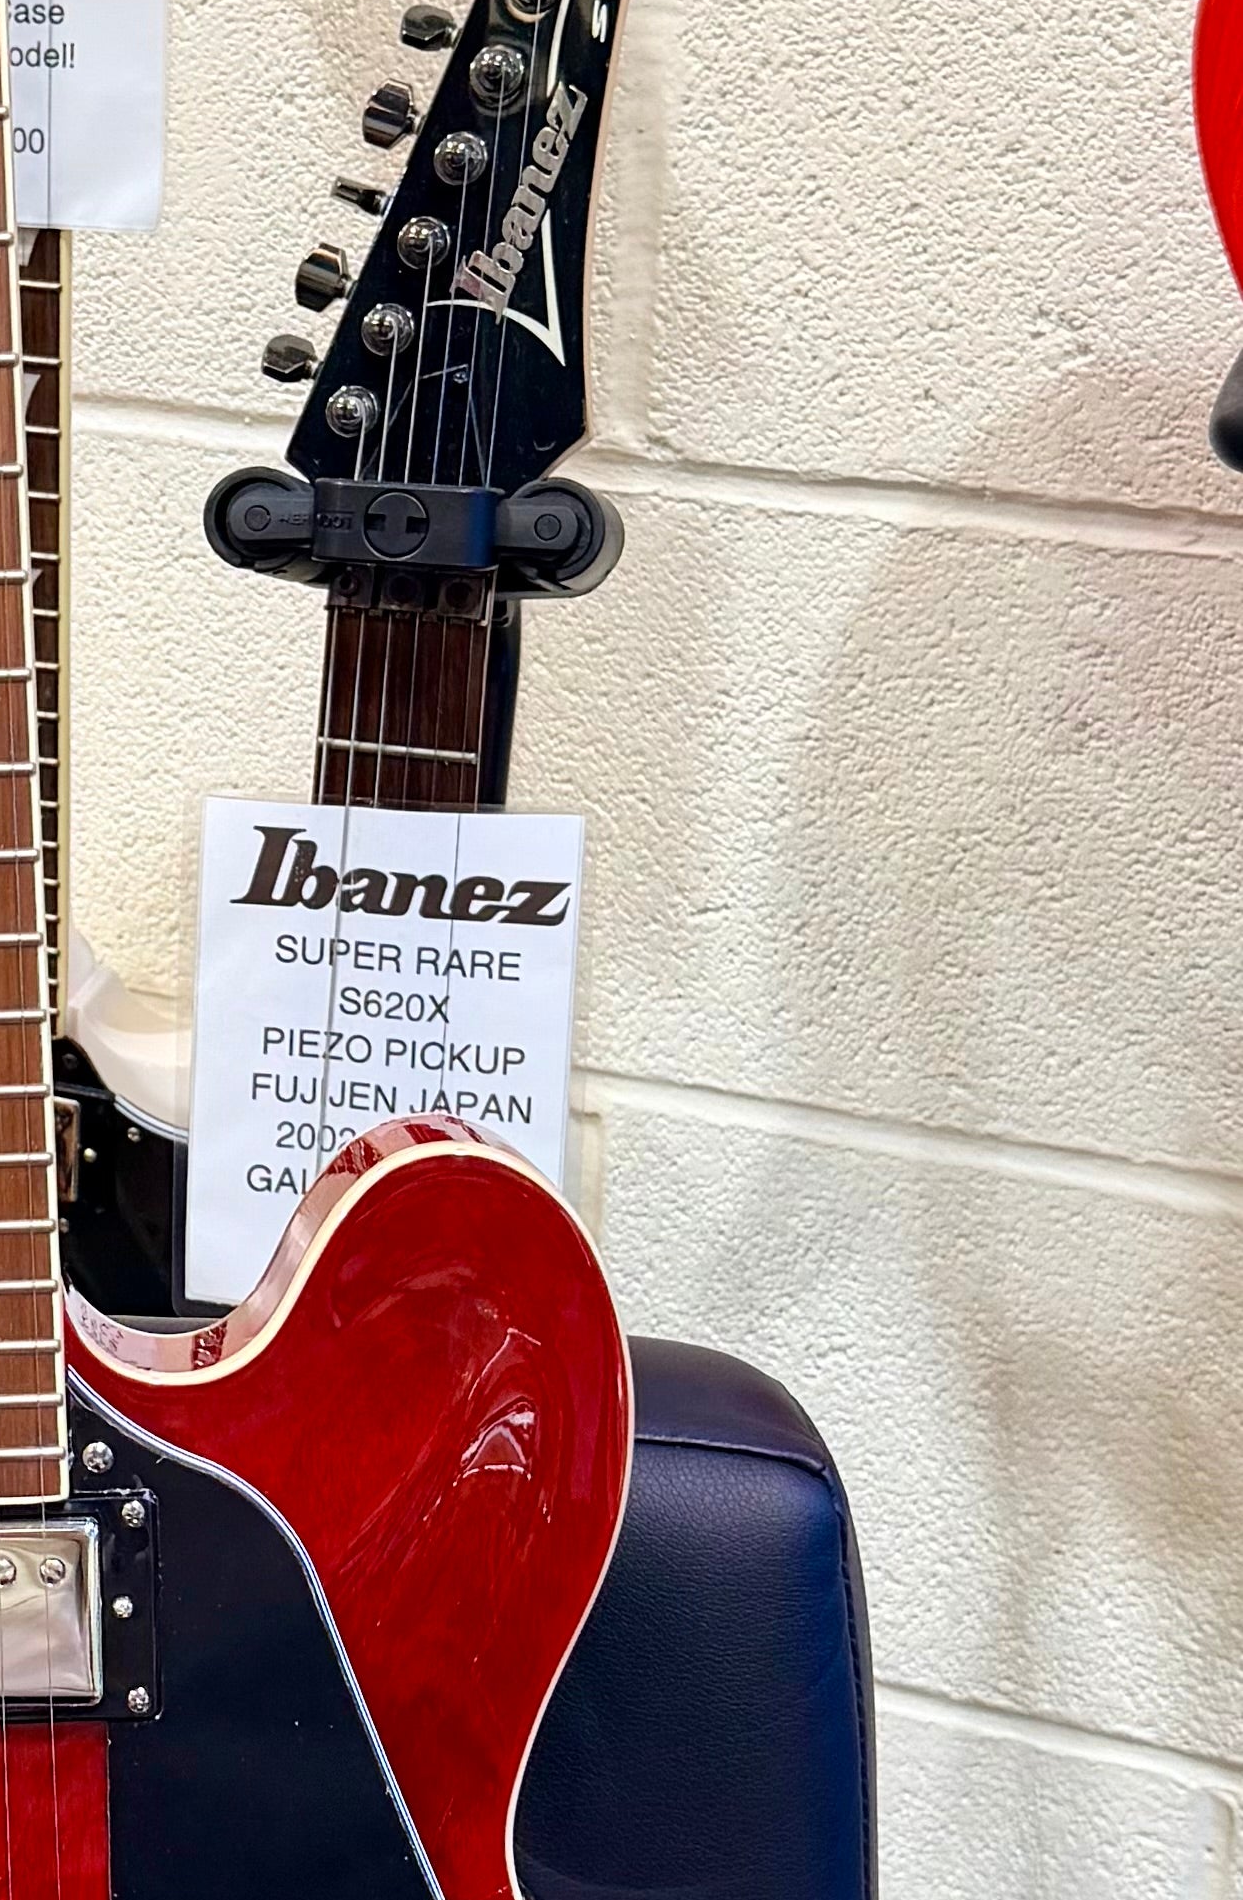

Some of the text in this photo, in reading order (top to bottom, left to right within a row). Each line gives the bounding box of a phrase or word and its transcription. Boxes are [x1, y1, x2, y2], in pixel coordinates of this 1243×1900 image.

[7, 0, 65, 24] ase
[450, 81, 588, 324] Ibanez
[230, 825, 572, 927] Ibanez
[275, 934, 522, 981] SUPER RARE
[339, 987, 451, 1024] S620X
[262, 1027, 526, 1076] PIEZO PICKUP
[410, 1087, 532, 1124] JAPAN
